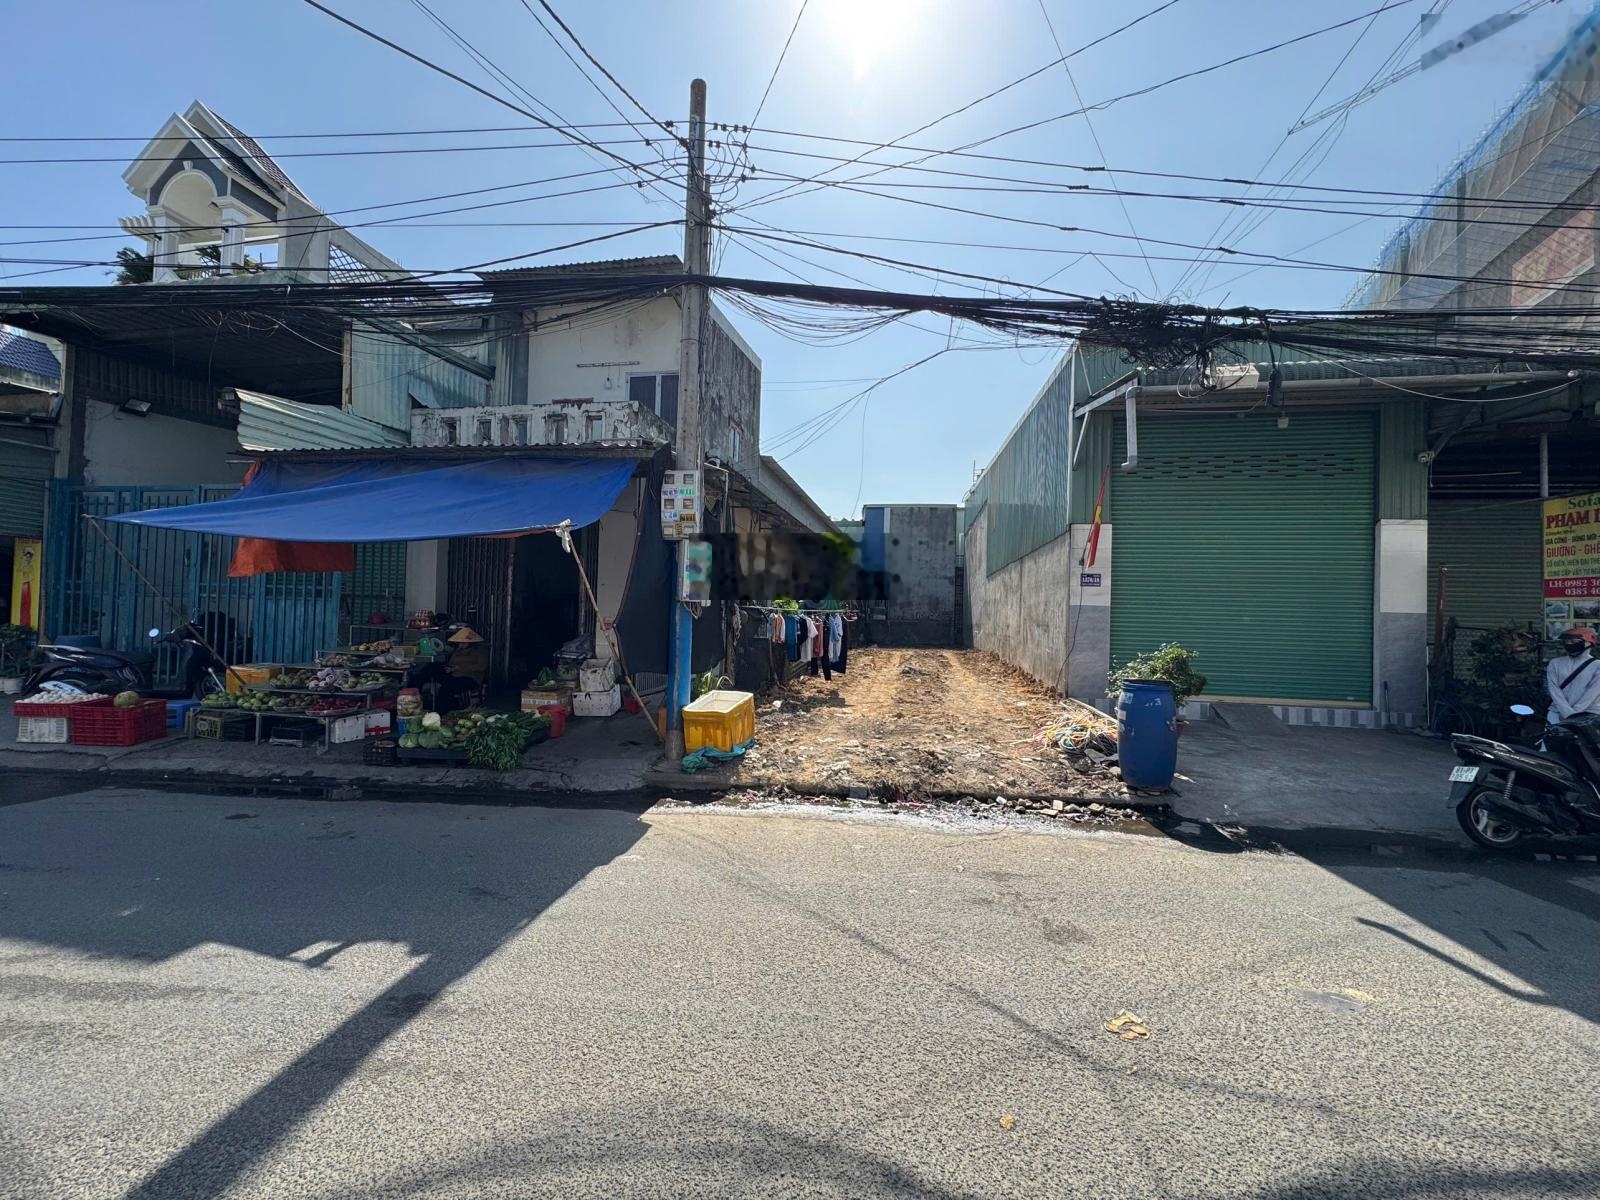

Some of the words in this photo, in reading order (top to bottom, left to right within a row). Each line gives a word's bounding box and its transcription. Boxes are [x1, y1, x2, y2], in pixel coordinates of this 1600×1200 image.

[1568, 495, 1600, 509] Sofa
[1546, 510, 1590, 528] PHẠM
[1546, 545, 1576, 558] GIƯỜNG
[1565, 587, 1588, 596] 0385
